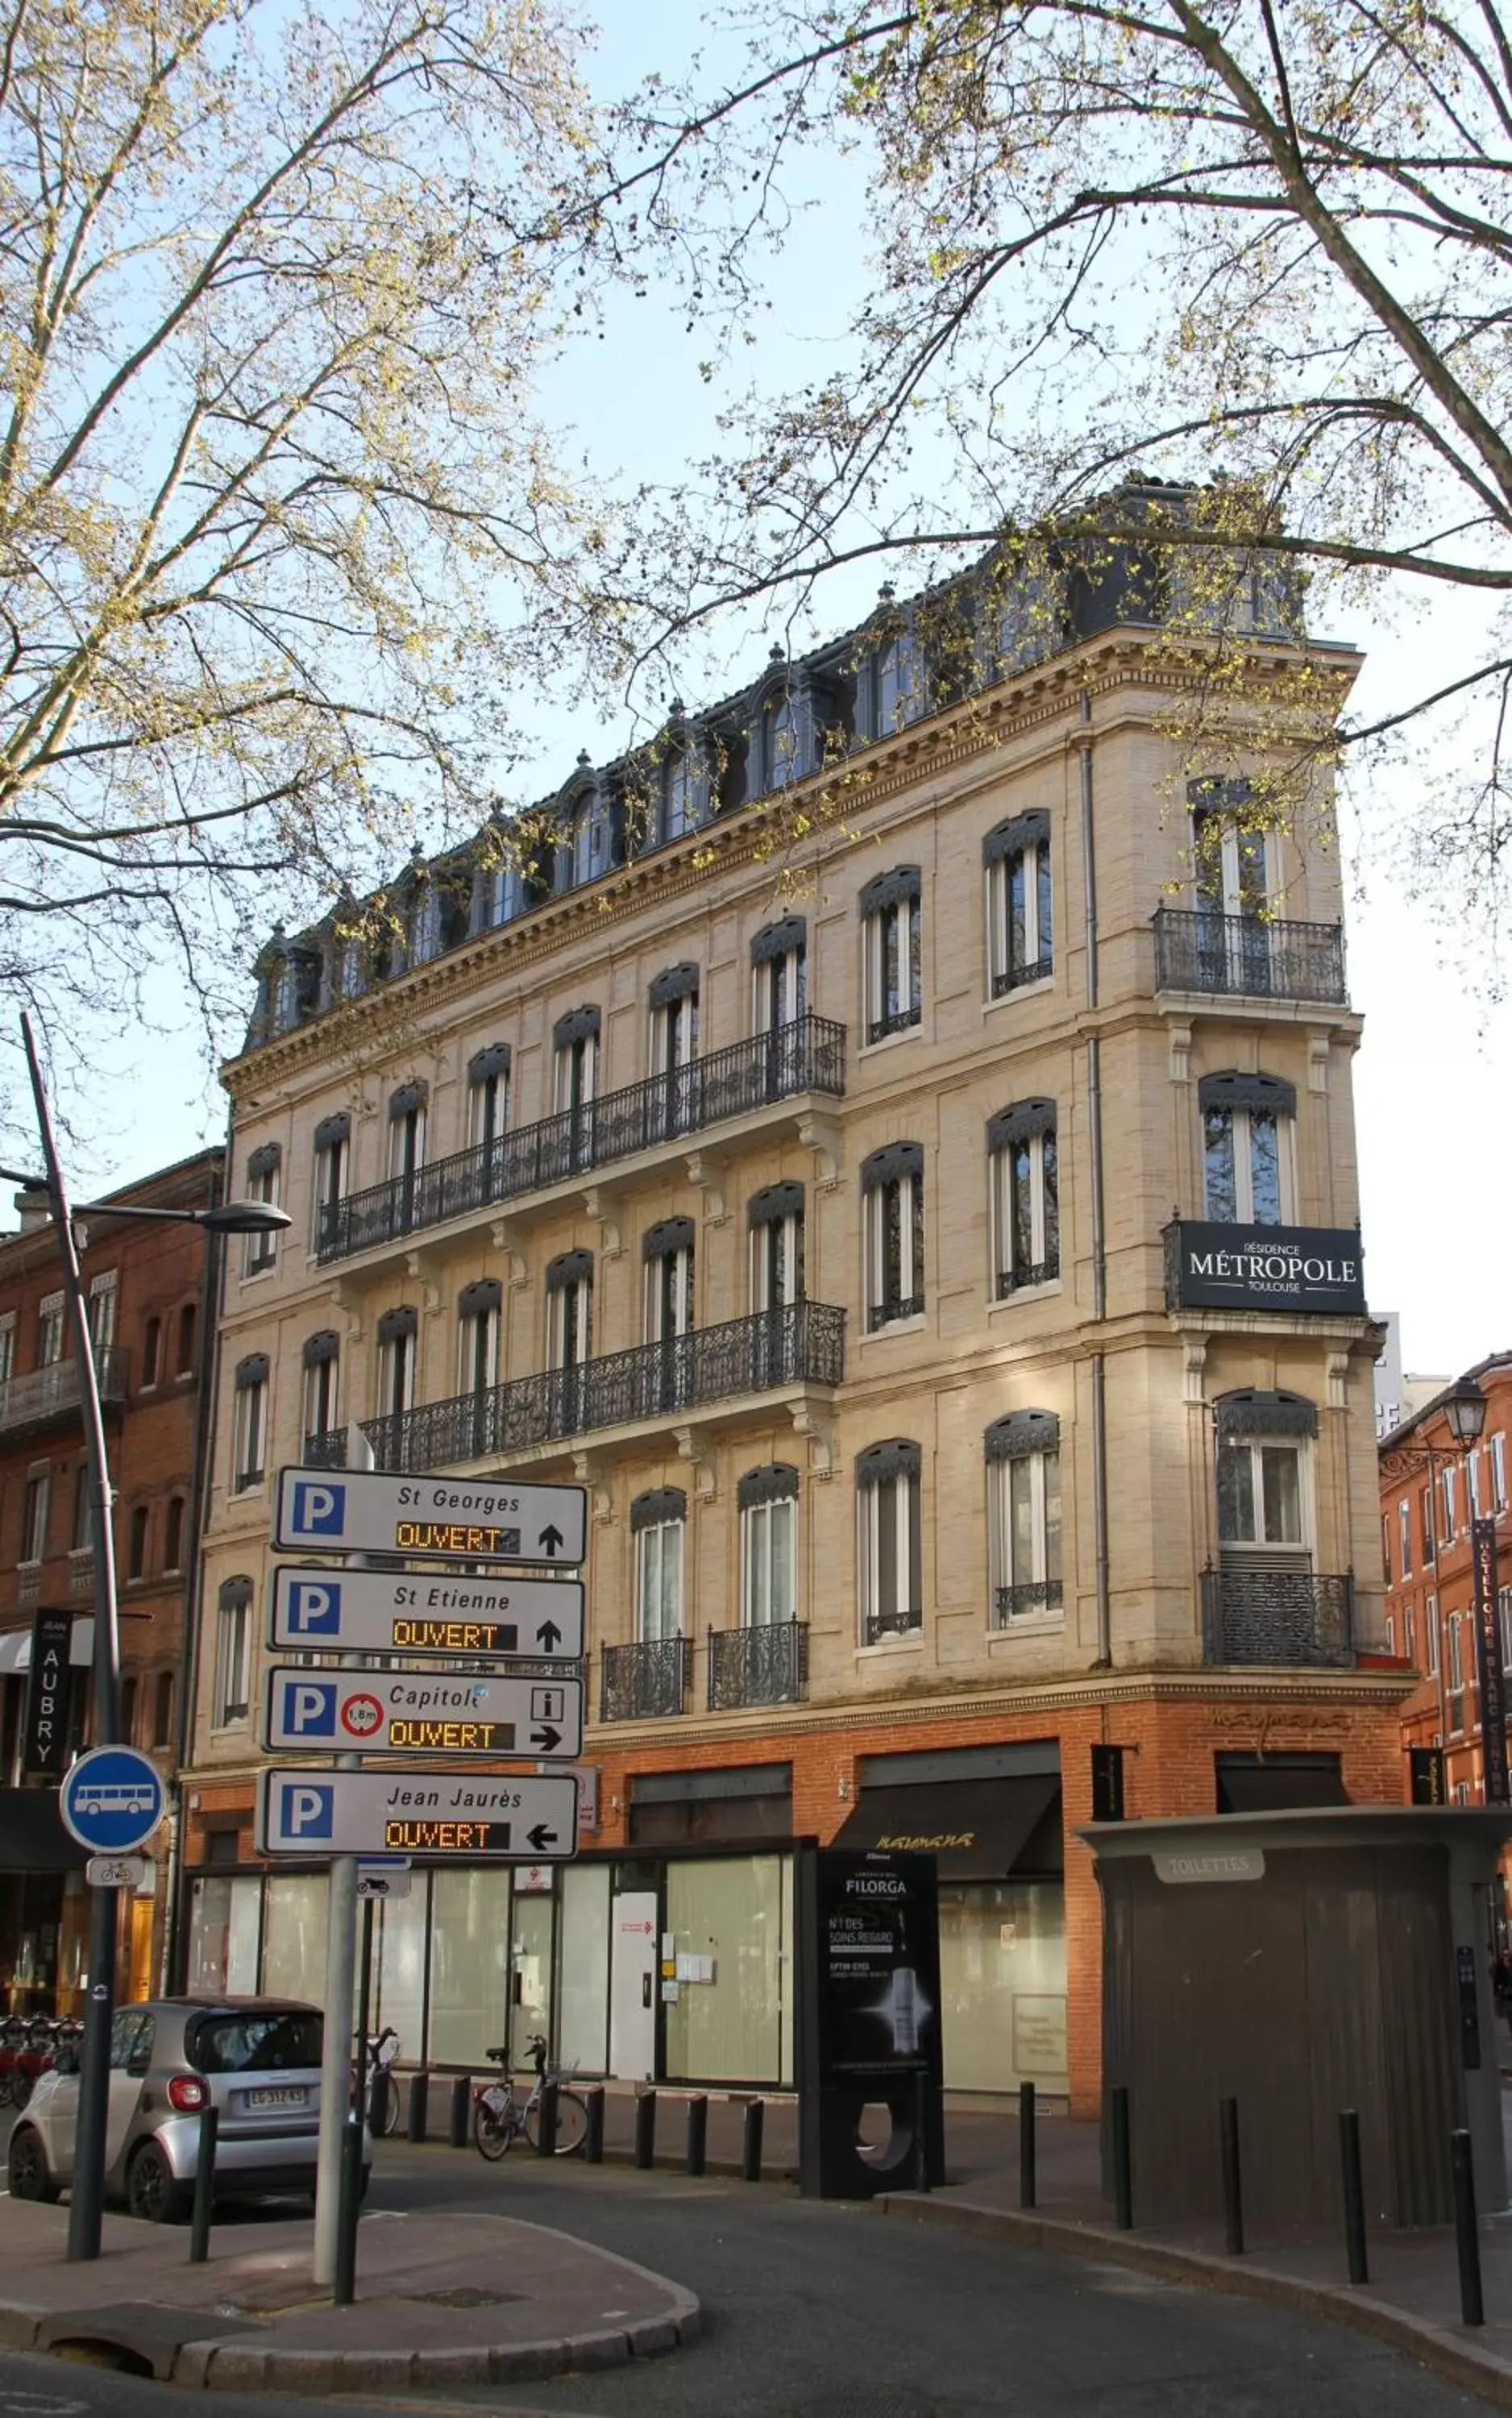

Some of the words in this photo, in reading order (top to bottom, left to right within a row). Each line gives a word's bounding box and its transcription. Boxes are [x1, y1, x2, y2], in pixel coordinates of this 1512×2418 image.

[1244, 1242, 1301, 1256] RÉSIDENCE
[1190, 1249, 1356, 1282] MÉTROPOLE
[1248, 1281, 1301, 1294] TOULOUSE
[302, 1486, 334, 1531] P
[398, 1487, 420, 1506] St
[433, 1489, 520, 1515] Georges
[397, 1523, 501, 1551] OUVERT
[297, 1585, 330, 1631] P
[394, 1587, 417, 1605] St
[427, 1589, 509, 1610] Etienne
[393, 1621, 498, 1648] OUVERT
[38, 1649, 59, 1763] AUBRY
[294, 1687, 326, 1732] P
[390, 1721, 495, 1748] OUVERT
[291, 1788, 323, 1834] P
[387, 1787, 439, 1807] Jean
[451, 1788, 521, 1808] Jaurès
[386, 1822, 491, 1850] OUVERT
[1170, 1856, 1248, 1876] TOILETTES
[846, 1880, 907, 1893] FILORGA
